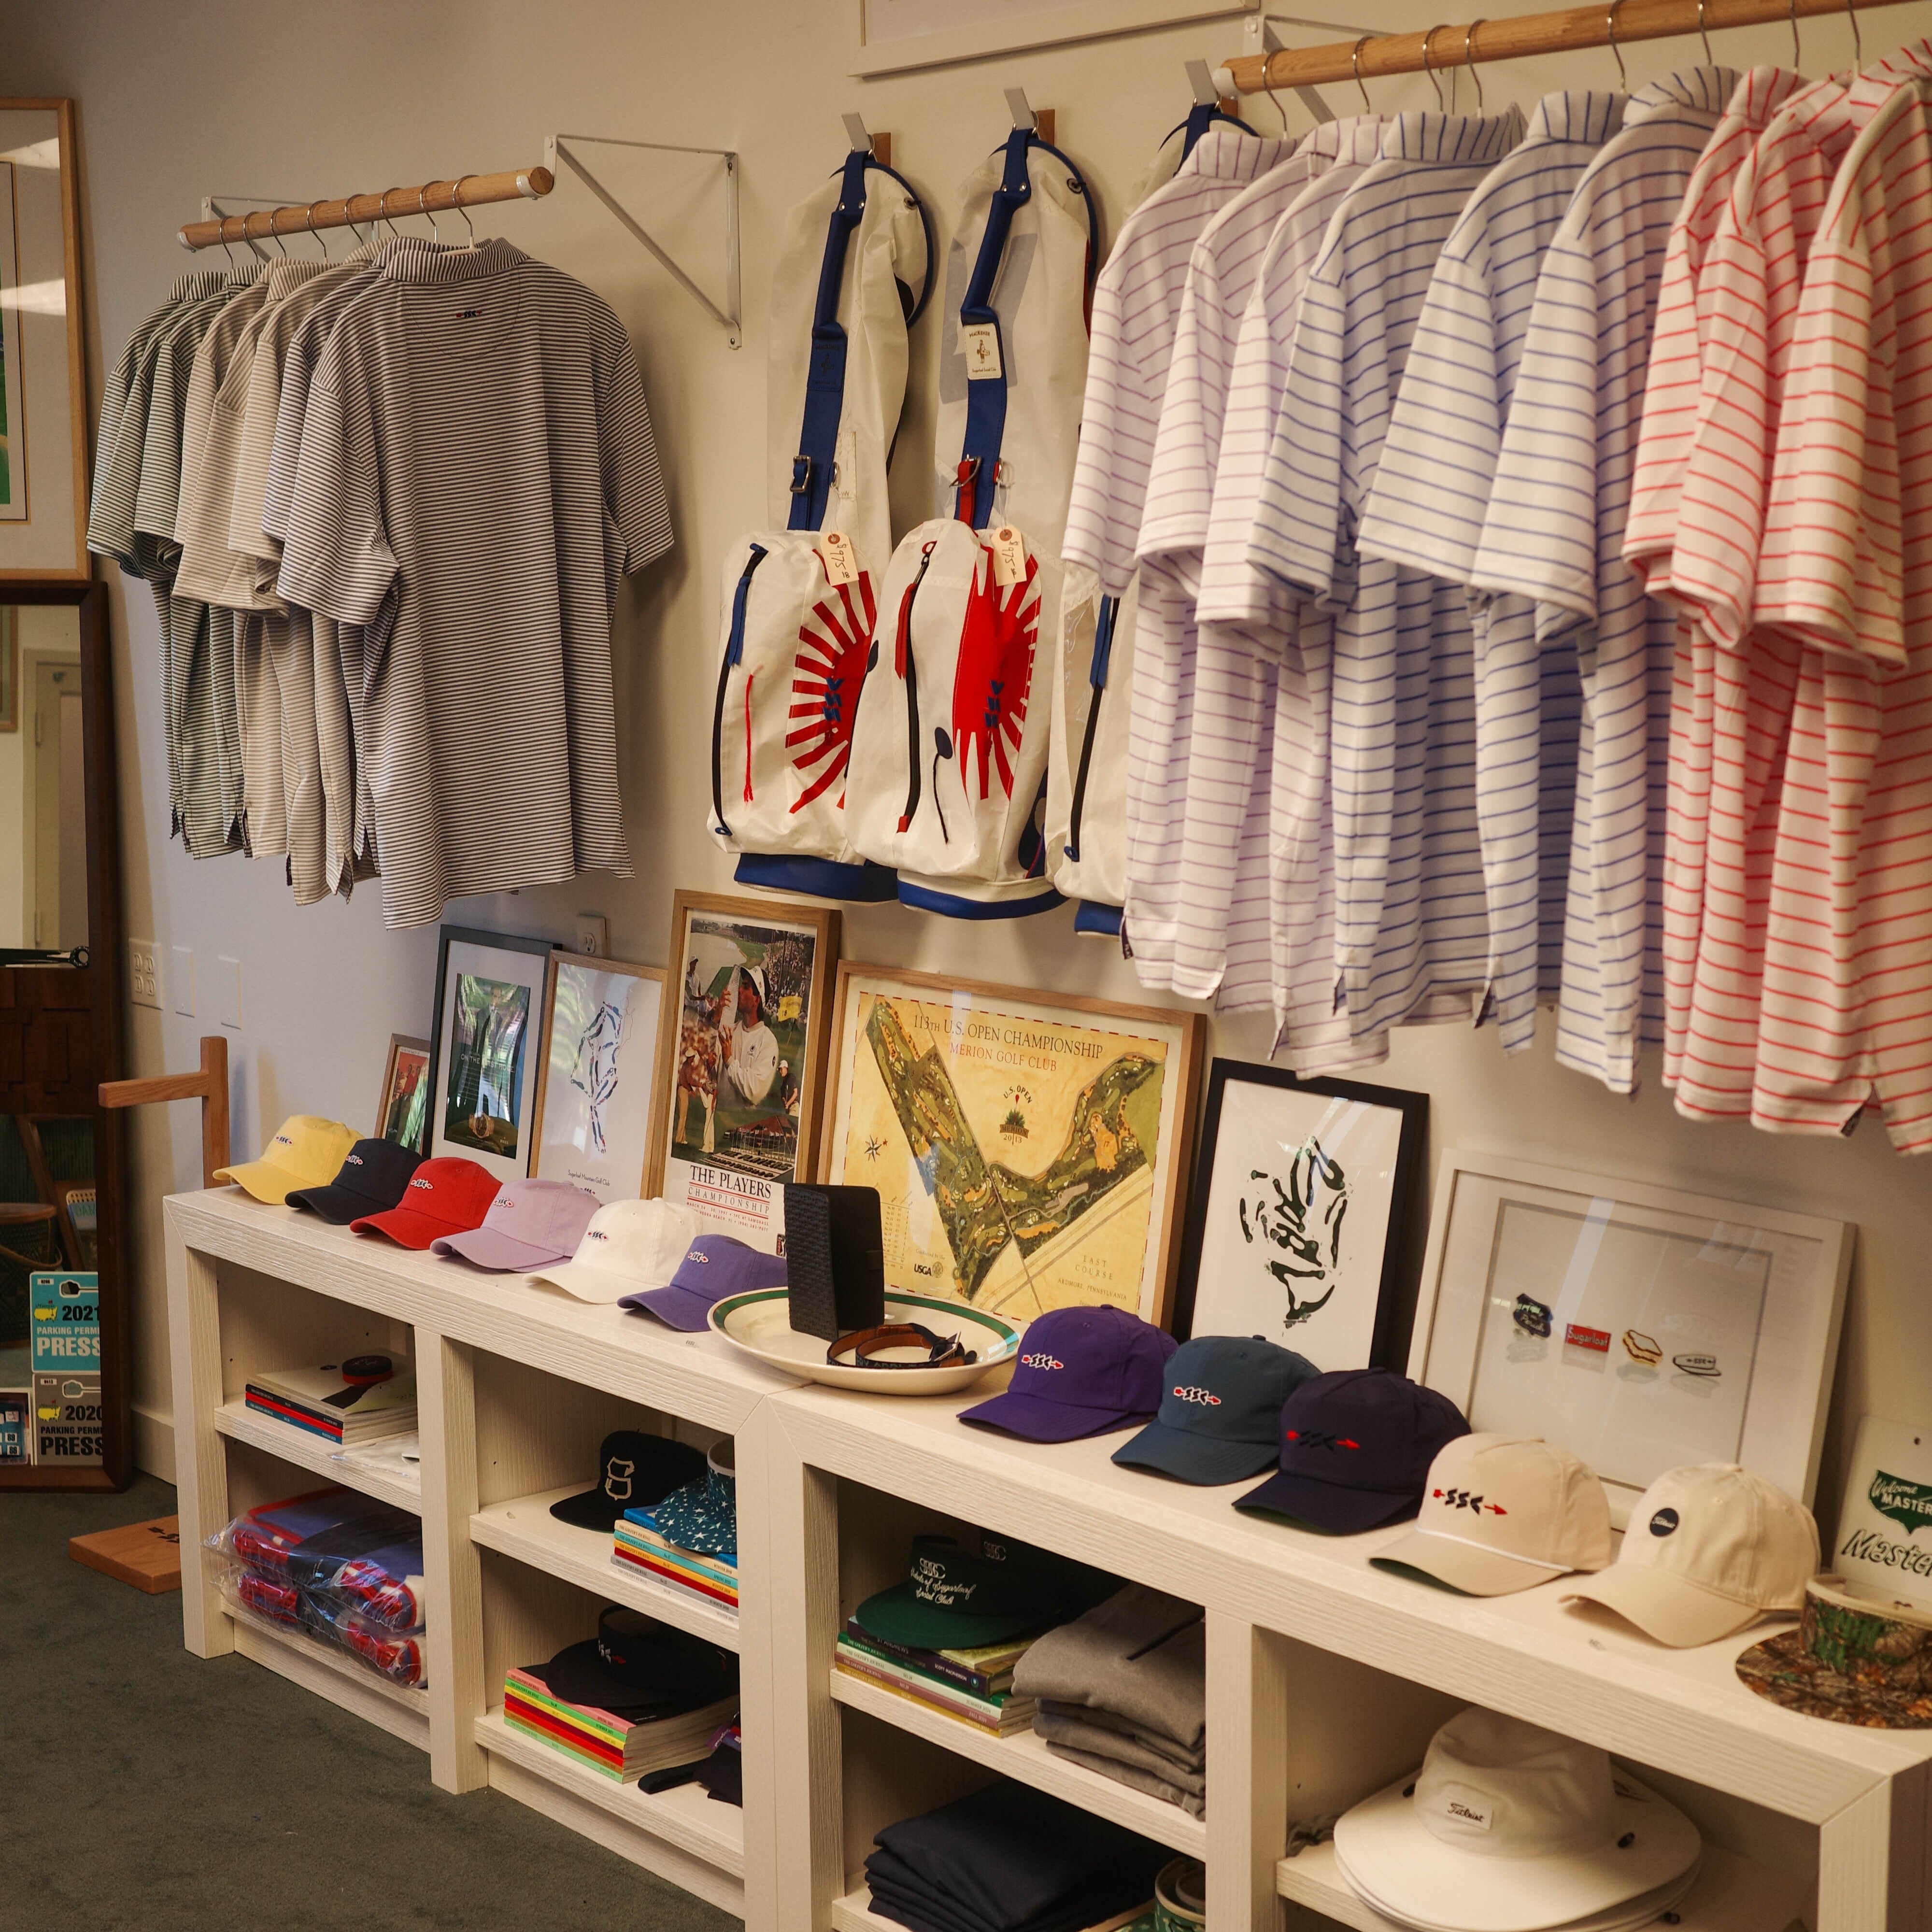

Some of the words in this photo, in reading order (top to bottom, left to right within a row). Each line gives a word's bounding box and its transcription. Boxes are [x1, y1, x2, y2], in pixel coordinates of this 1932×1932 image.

[913, 1014, 939, 1032] 113TH
[944, 1019, 964, 1036] U.S.
[968, 1023, 1000, 1041] OPEN
[1004, 1029, 1103, 1059] CHAMPIONSHIP
[469, 1056, 480, 1065] THE
[950, 1043, 993, 1059] MERION
[996, 1051, 1024, 1065] GOLF
[1028, 1056, 1057, 1072] CLUB
[1003, 1086, 1015, 1099] U.S.
[1017, 1085, 1032, 1104] OPEN
[690, 1165, 715, 1185] THE
[719, 1172, 771, 1199] PLAYERS
[688, 1186, 769, 1214] CHAMPIONSHIP
[748, 1218, 769, 1226] SAWGRASS
[914, 1264, 932, 1276] USGA
[1083, 1255, 1107, 1268] EAST
[1075, 1264, 1113, 1280] COURSE
[1058, 1278, 1085, 1290] ARDMORE,
[1087, 1284, 1127, 1300] PENNSYLVANIA
[1568, 1327, 1608, 1347] Sugarloaf
[37, 1337, 100, 1357] PRESS
[41, 1436, 103, 1456] PRESS
[1871, 1477, 1918, 1497] Welcome
[714, 1563, 725, 1572] WINTER
[712, 1582, 724, 1591] WINTER
[714, 1574, 724, 1583] SPRING
[933, 1580, 977, 1600] Sugarloaf
[935, 1594, 954, 1605] Club
[854, 1641, 870, 1652] GOLFER'S
[871, 1649, 885, 1659] JOURNAL
[851, 1662, 867, 1673] GOLFER'S
[867, 1668, 881, 1678] JOURNAL
[935, 1663, 945, 1672] SCOTT
[853, 1652, 869, 1662] GOLFER'S
[869, 1658, 884, 1669] JOURNAL
[966, 1699, 982, 1709] SUMMER
[1447, 1802, 1485, 1822] Titleist
